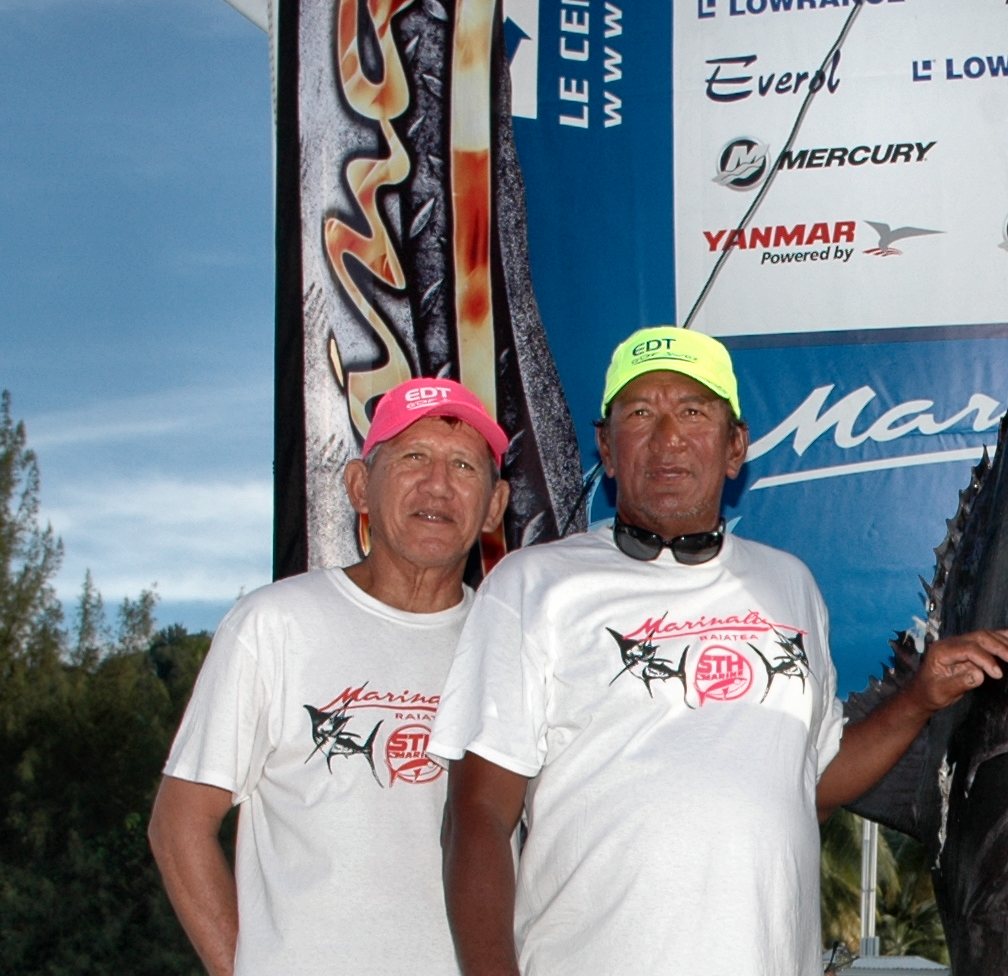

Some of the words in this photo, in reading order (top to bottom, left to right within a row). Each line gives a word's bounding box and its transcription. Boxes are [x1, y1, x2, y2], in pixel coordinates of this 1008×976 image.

[560, 0, 590, 61] CE
[704, 49, 842, 102] Everol
[559, 77, 589, 129] LE
[778, 141, 938, 171] MERCURY
[703, 220, 857, 252] YANMAR
[761, 247, 829, 265] Powered
[833, 246, 855, 262] by
[632, 338, 677, 357] EDT
[404, 386, 452, 403] EDT
[743, 383, 1008, 462] Mar
[395, 712, 436, 721] RAIA
